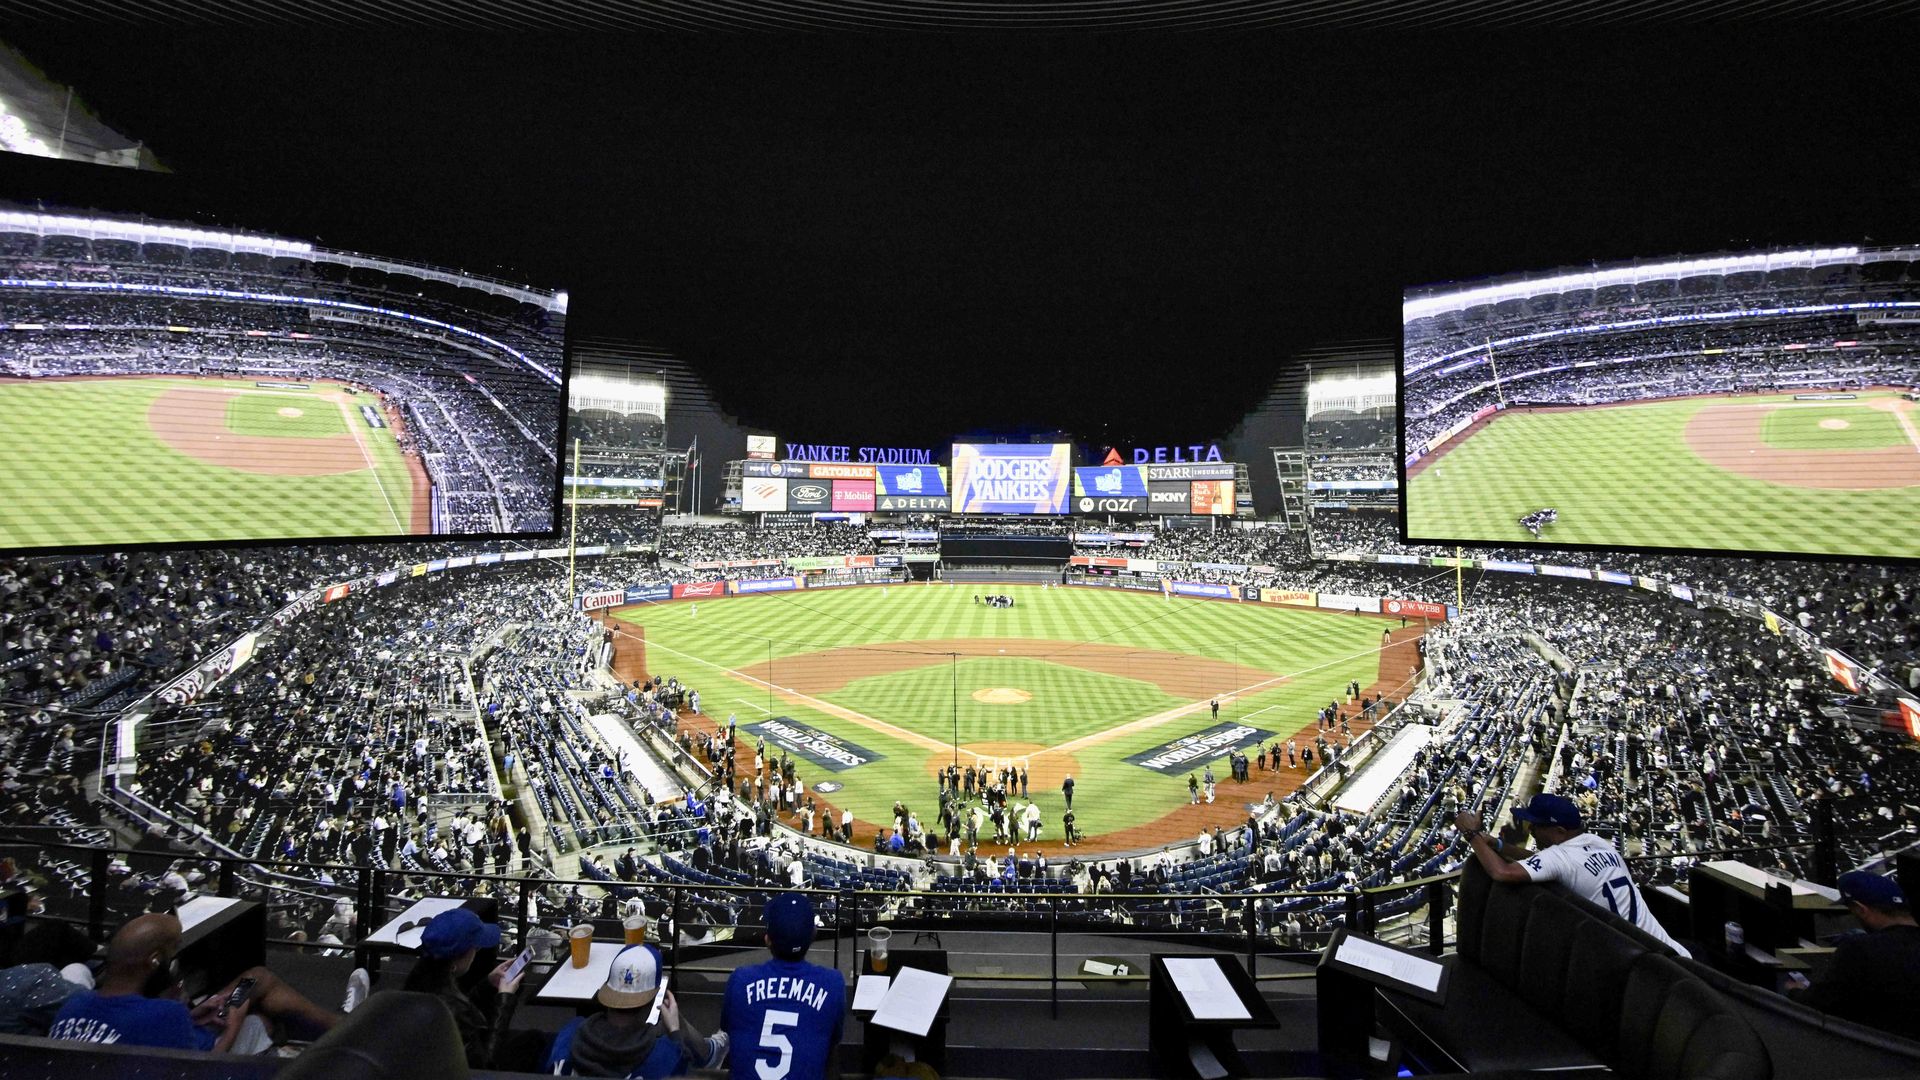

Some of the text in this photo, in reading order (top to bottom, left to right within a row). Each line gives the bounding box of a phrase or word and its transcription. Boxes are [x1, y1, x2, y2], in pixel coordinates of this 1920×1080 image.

[786, 443, 932, 465] YANKEE STADIUM
[1134, 445, 1223, 464] DELTA
[812, 466, 874, 478] GATORADE
[973, 459, 1050, 480] DODGERS
[1149, 467, 1234, 479] STARR INSURANCE
[797, 487, 822, 499] Ford
[844, 489, 874, 501] Mobile
[971, 480, 1050, 501] YANKEES
[1151, 492, 1188, 503] DKNY
[897, 498, 948, 509] DELTA
[1098, 499, 1138, 512] razr
[583, 592, 623, 610] Canon
[1282, 593, 1310, 602] MASON
[1402, 602, 1441, 615] F.W. WEBB
[759, 720, 813, 744] WORLD
[804, 741, 867, 766] SERIES
[1139, 744, 1211, 769] WORLD
[1211, 726, 1257, 748] SERIES
[1526, 855, 1543, 872] LA
[1584, 851, 1621, 877] OHTANI
[1602, 876, 1638, 925] 17
[745, 977, 829, 1012] FREEMAN
[755, 1009, 799, 1080] 5
